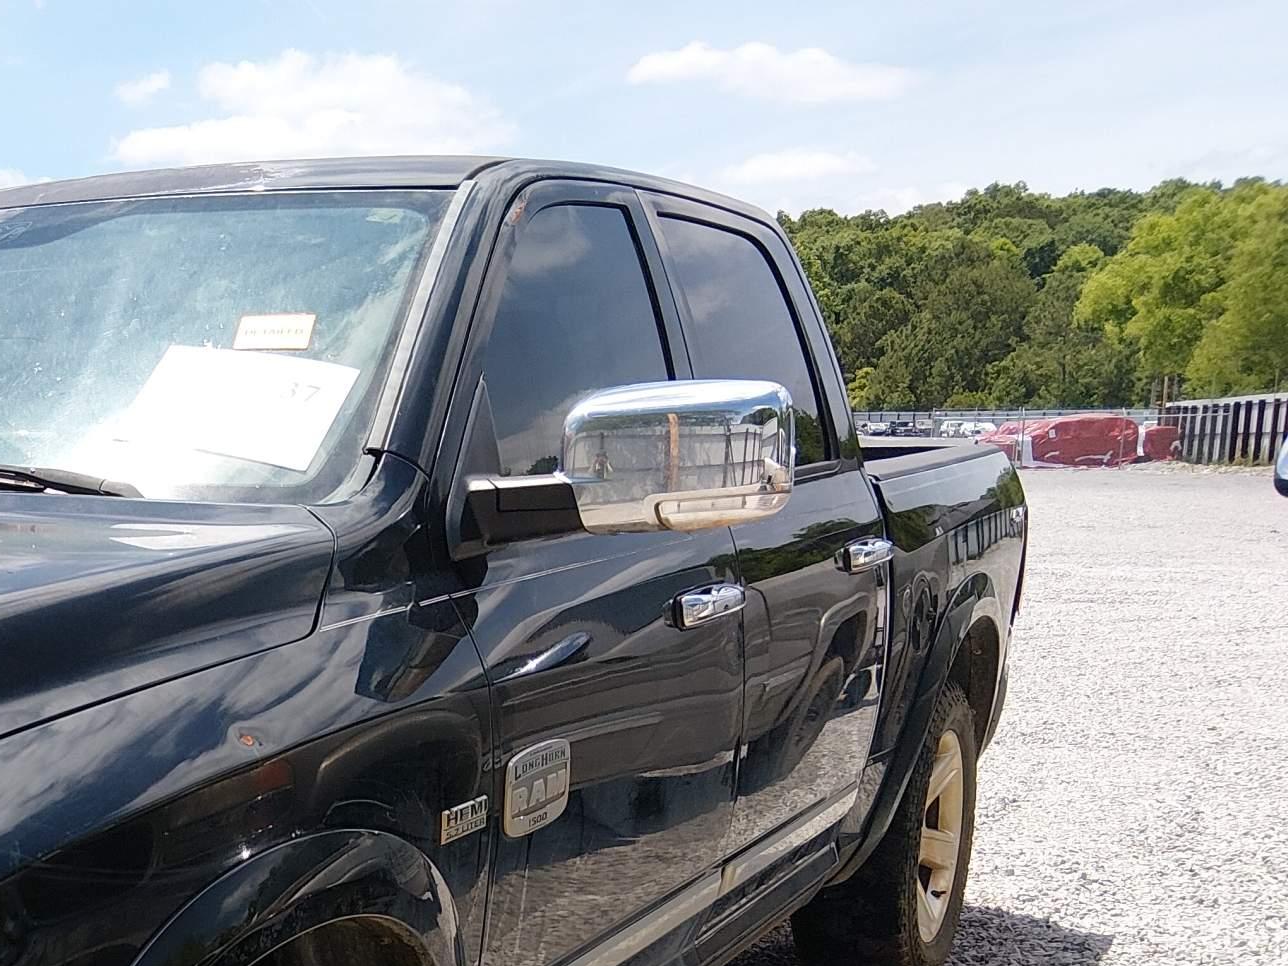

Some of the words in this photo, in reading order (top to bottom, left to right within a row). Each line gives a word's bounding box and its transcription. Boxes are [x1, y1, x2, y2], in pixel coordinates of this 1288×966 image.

[512, 768, 566, 815] RAM
[446, 800, 488, 828] HEMI
[528, 811, 548, 828] 1500
[462, 817, 485, 834] LITER
